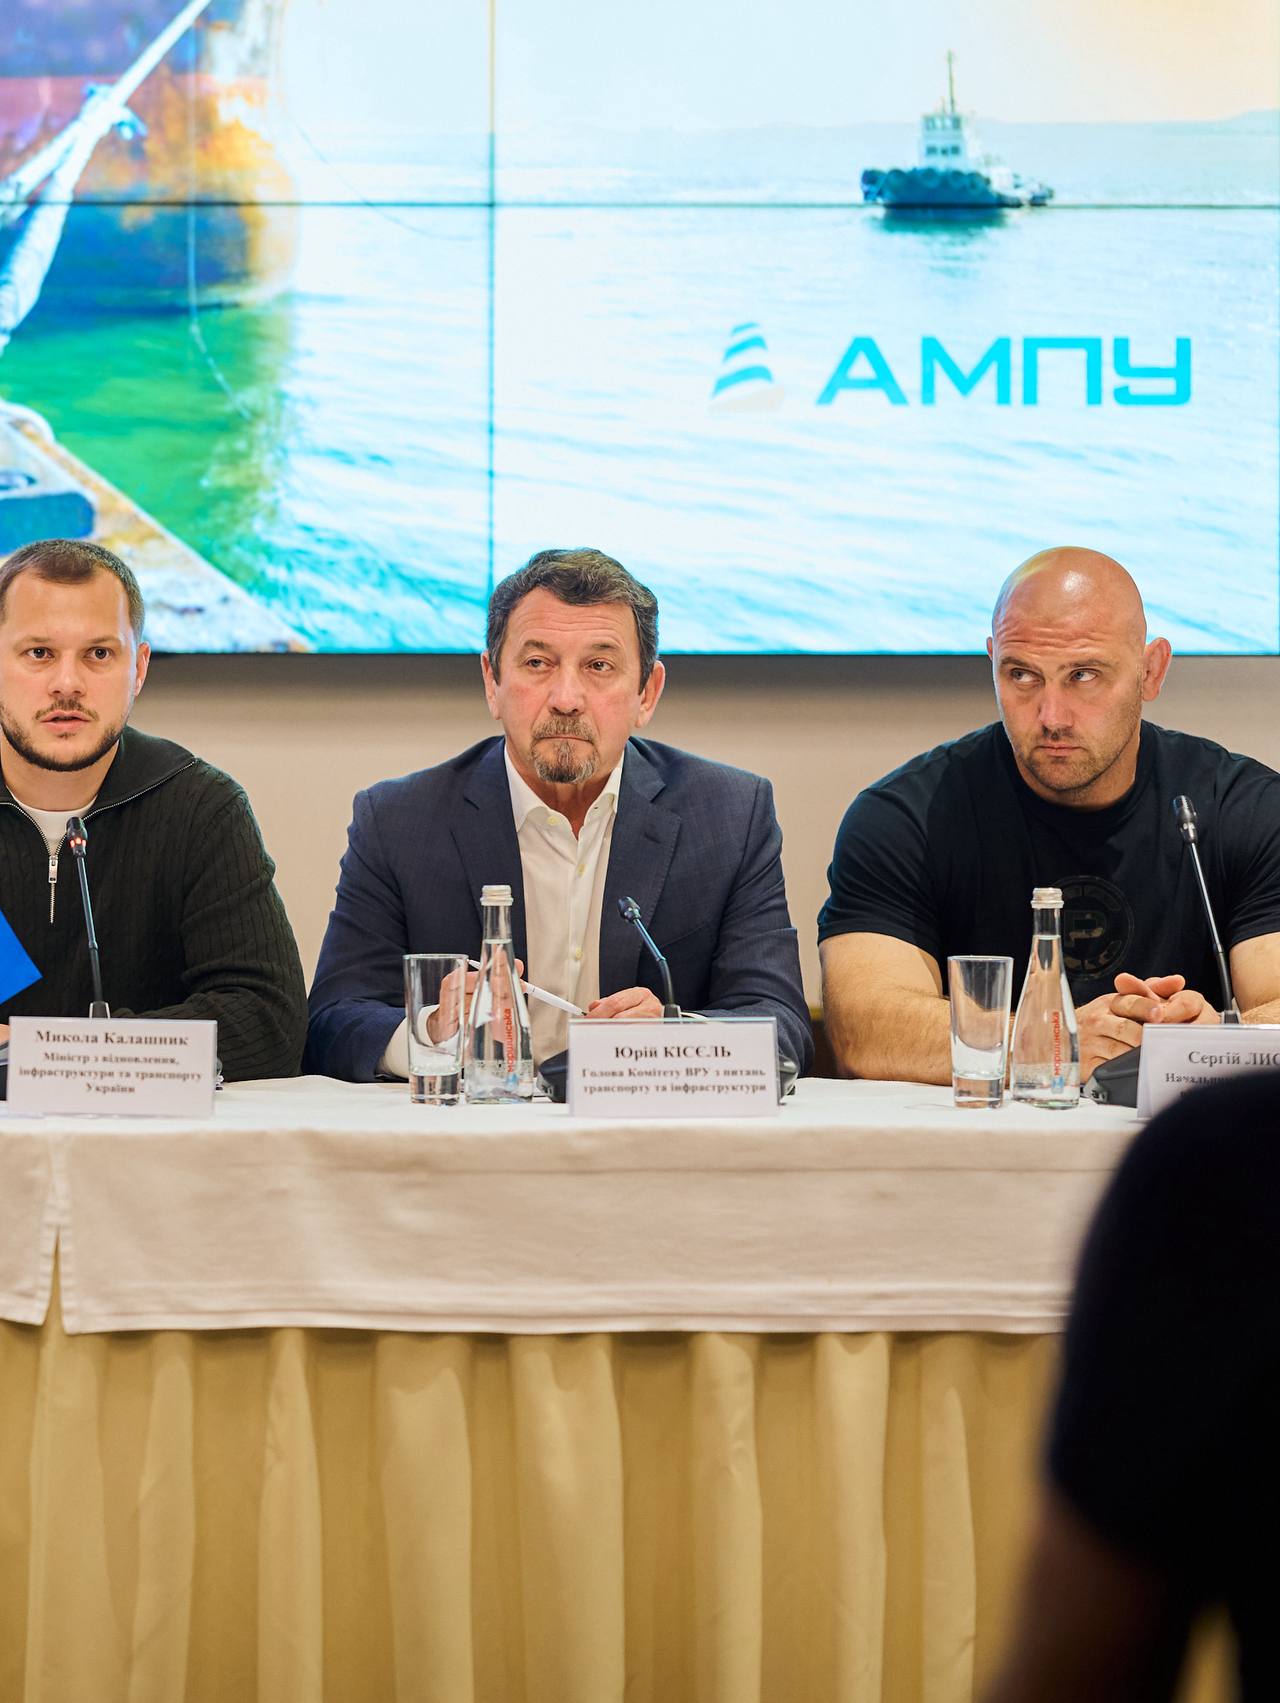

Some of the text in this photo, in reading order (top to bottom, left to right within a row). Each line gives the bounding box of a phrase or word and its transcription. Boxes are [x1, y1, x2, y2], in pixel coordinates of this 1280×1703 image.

[814, 335, 1193, 408] АМПУ
[36, 1030, 189, 1047] Микола Калашник
[43, 1052, 90, 1065] Міністр
[615, 1045, 658, 1062] Юрій
[1188, 1050, 1240, 1067] Сергій
[19, 1066, 115, 1080] інфраструктури
[135, 1071, 202, 1081] транспорту
[582, 1068, 625, 1078] Голова
[685, 1068, 709, 1078] ВРУ
[723, 1069, 766, 1078] питань
[85, 1083, 136, 1095] України
[583, 1082, 767, 1095] транспорту та інфраструктури
